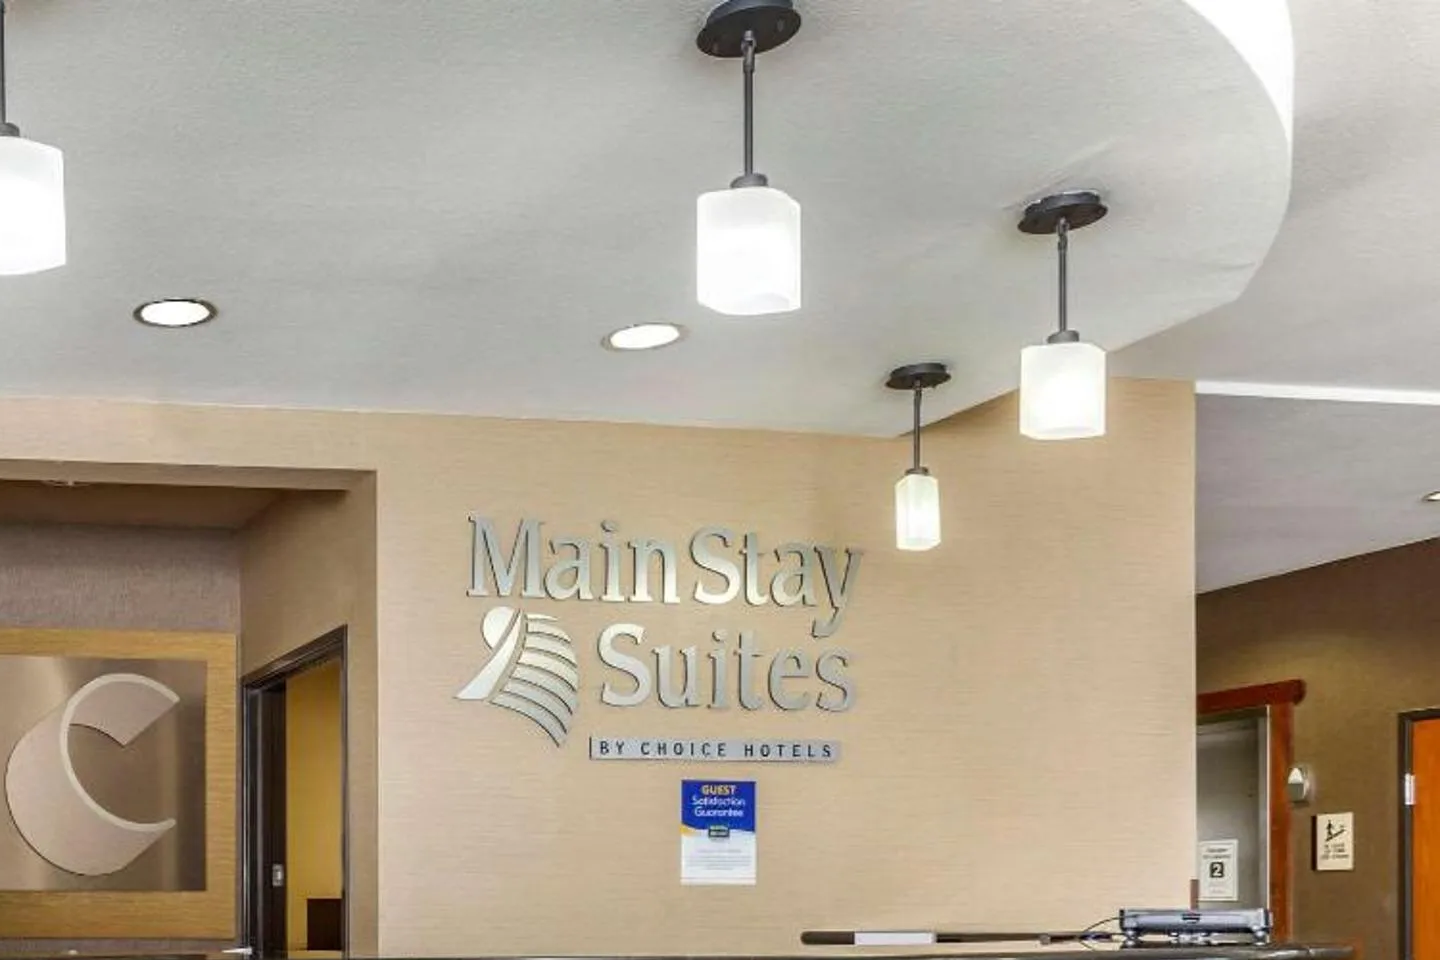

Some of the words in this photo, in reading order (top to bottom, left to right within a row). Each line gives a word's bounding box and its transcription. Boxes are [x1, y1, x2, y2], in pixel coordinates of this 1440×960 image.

[596, 622, 857, 713] Suites
[599, 740, 625, 755] BY
[640, 741, 727, 757] CHOICE
[744, 743, 832, 758] HOTELS
[701, 784, 737, 796] GUEST
[694, 806, 744, 818] Guarantee
[1212, 864, 1223, 877] 2
